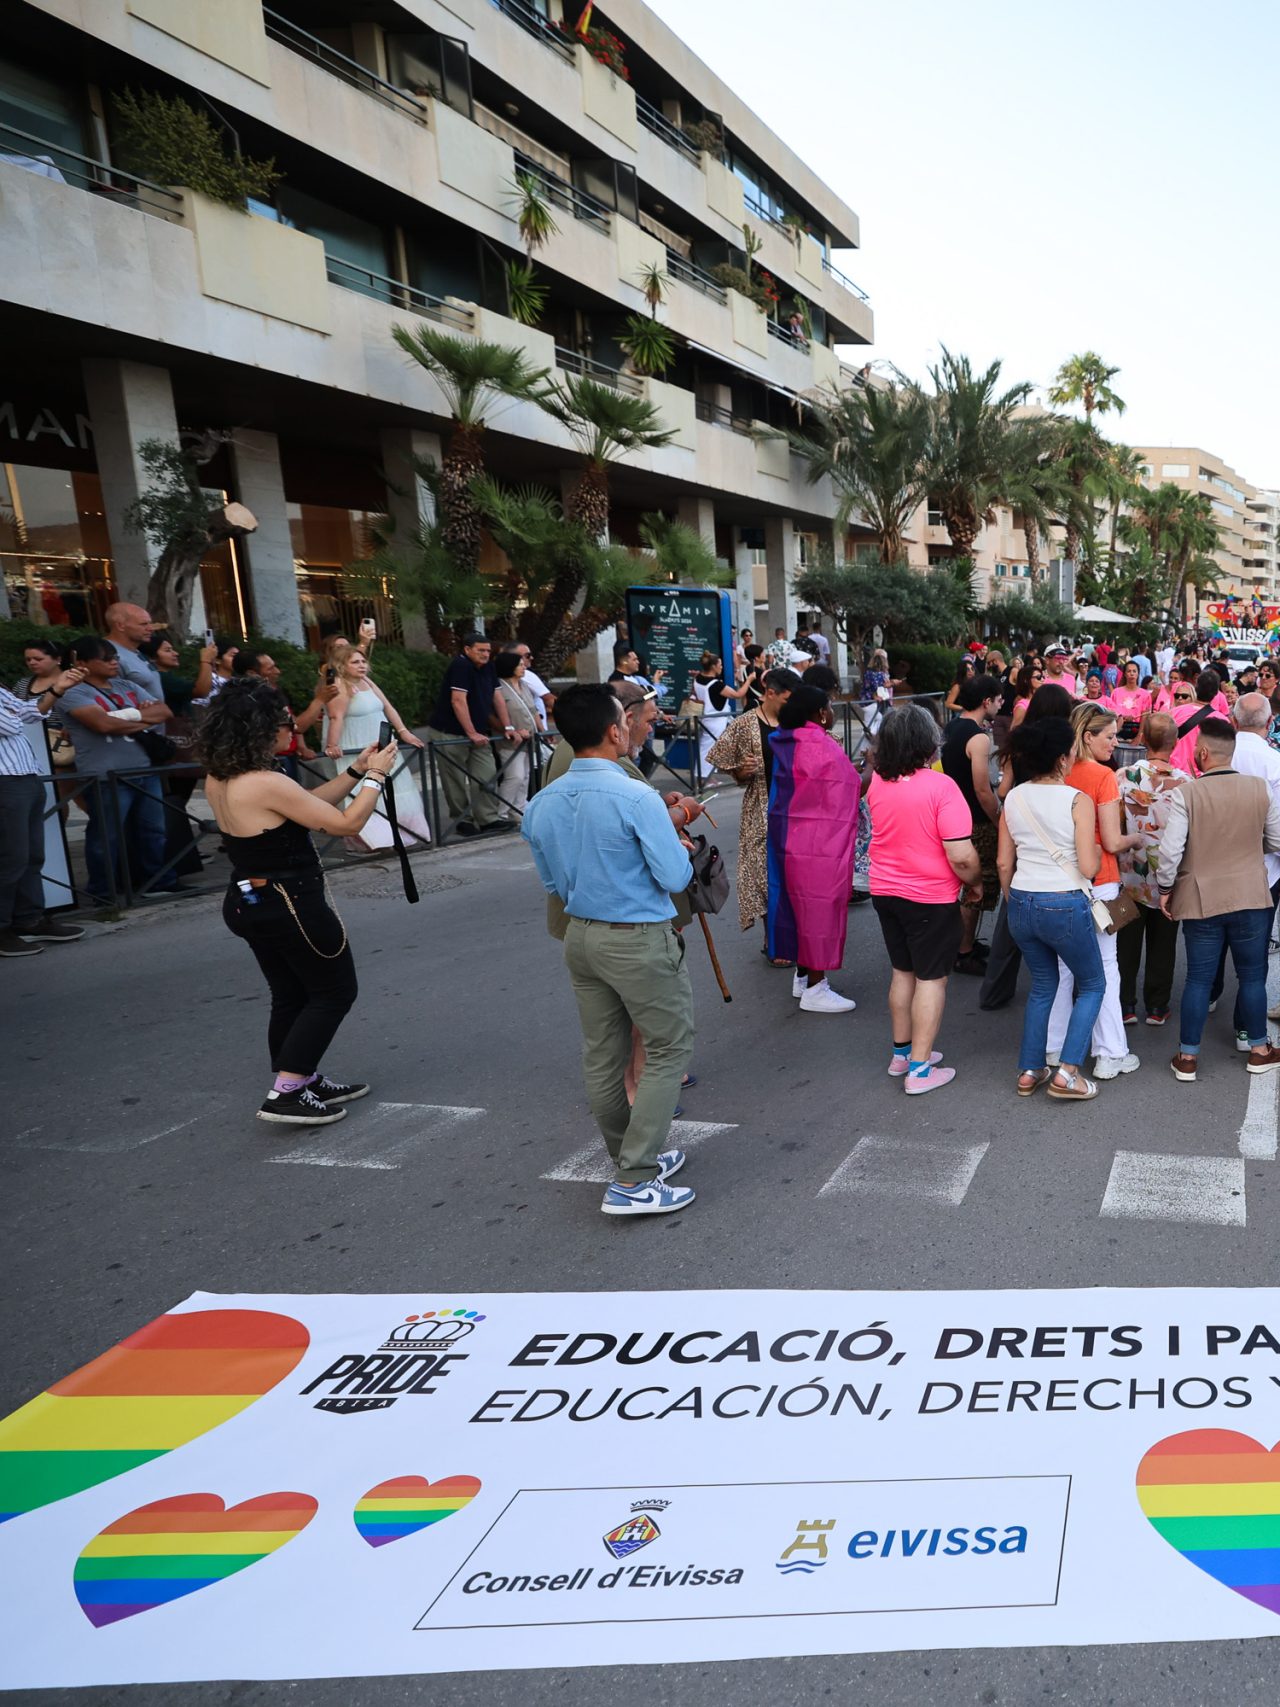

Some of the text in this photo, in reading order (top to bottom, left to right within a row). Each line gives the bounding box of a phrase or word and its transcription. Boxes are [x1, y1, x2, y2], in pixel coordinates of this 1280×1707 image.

[1219, 627, 1273, 643] EIVISSA
[508, 1320, 907, 1367] EDUCACIÓ,
[934, 1326, 1143, 1360] DRETS
[1168, 1325, 1180, 1356] I
[299, 1353, 470, 1395] PRIDE
[321, 1399, 389, 1407] IBIZA
[468, 1376, 892, 1423] EDUCACIÓN,
[917, 1376, 1253, 1414] DERECHOS
[847, 1525, 1028, 1559] eivissa
[462, 1564, 744, 1594] Consell d'Eivissa
